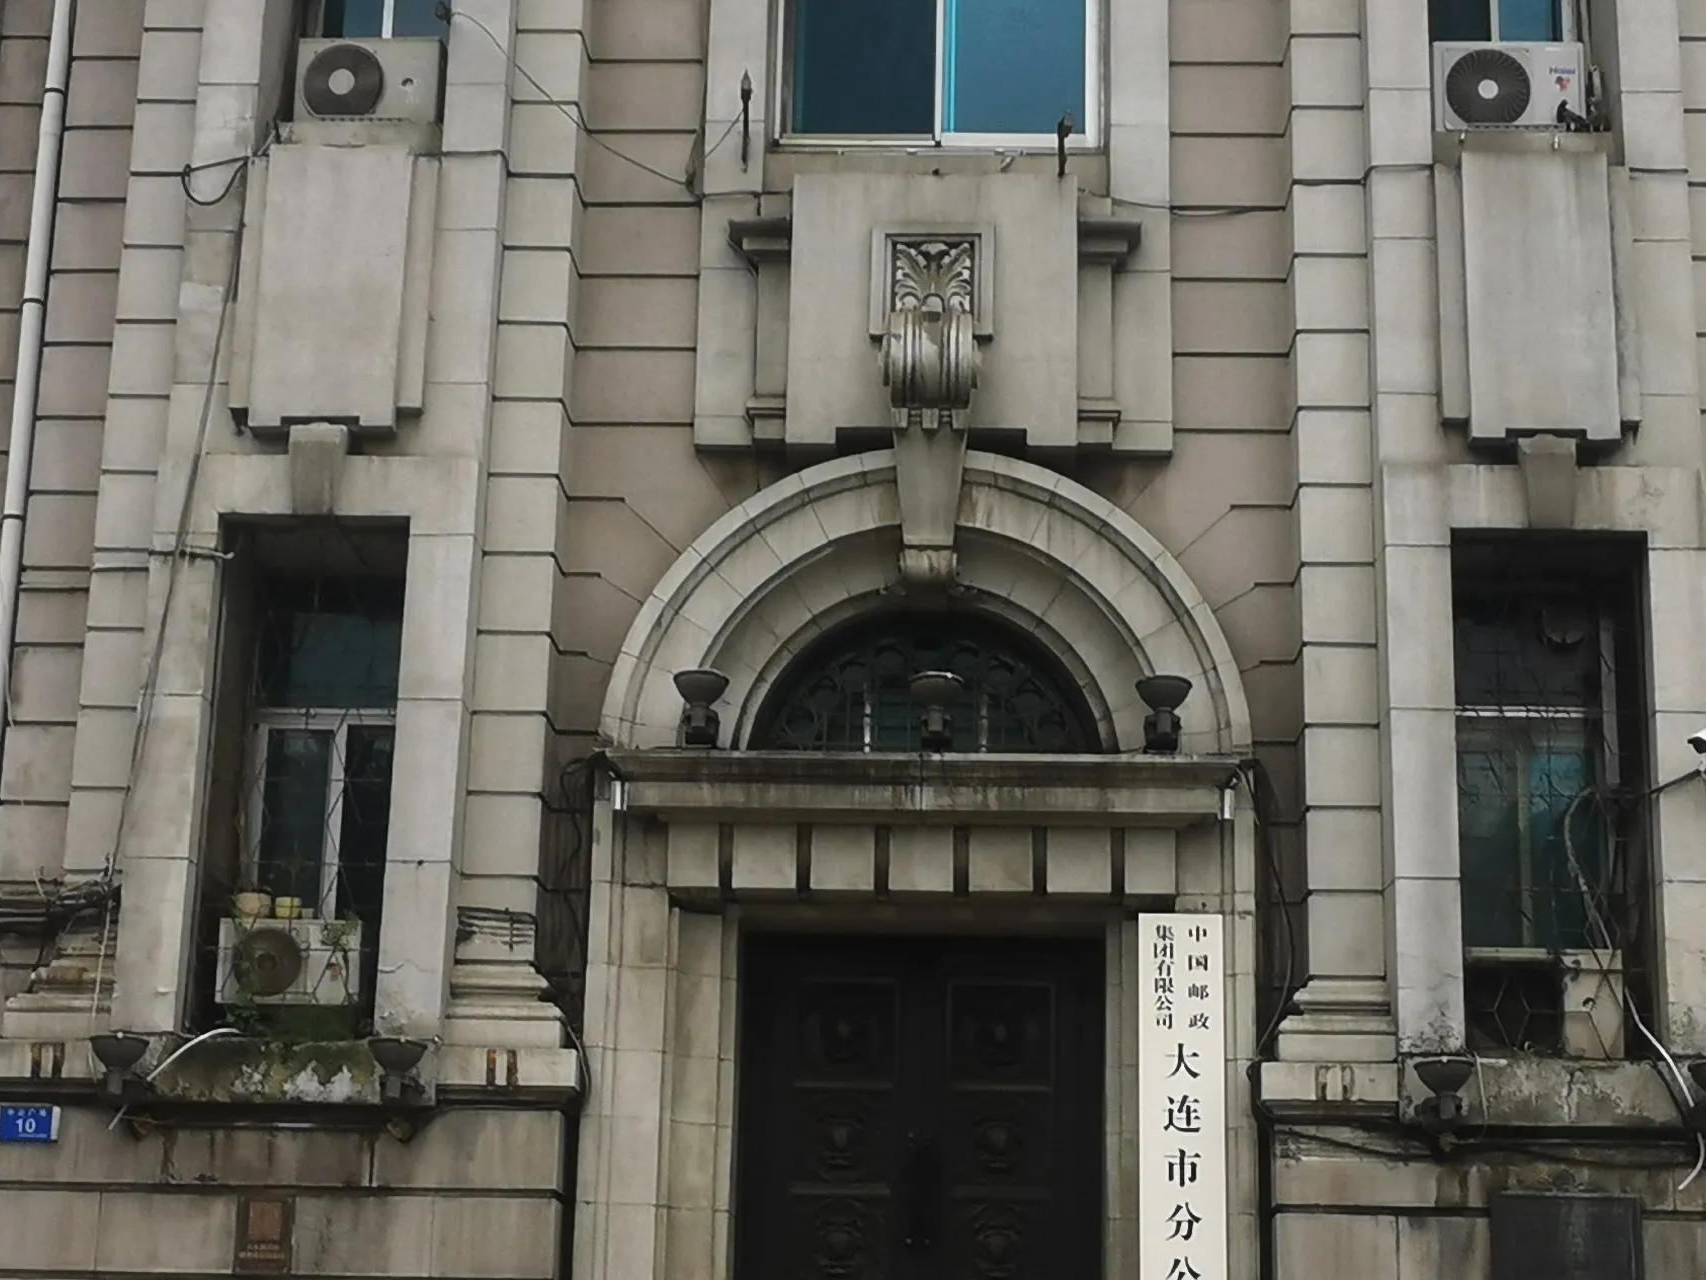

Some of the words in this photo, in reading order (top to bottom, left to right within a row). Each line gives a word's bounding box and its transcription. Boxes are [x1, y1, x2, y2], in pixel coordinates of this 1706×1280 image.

[1153, 924, 1175, 1030] 集团有限公司
[1187, 925, 1210, 1030] 中国邮政
[15, 1118, 36, 1133] 10
